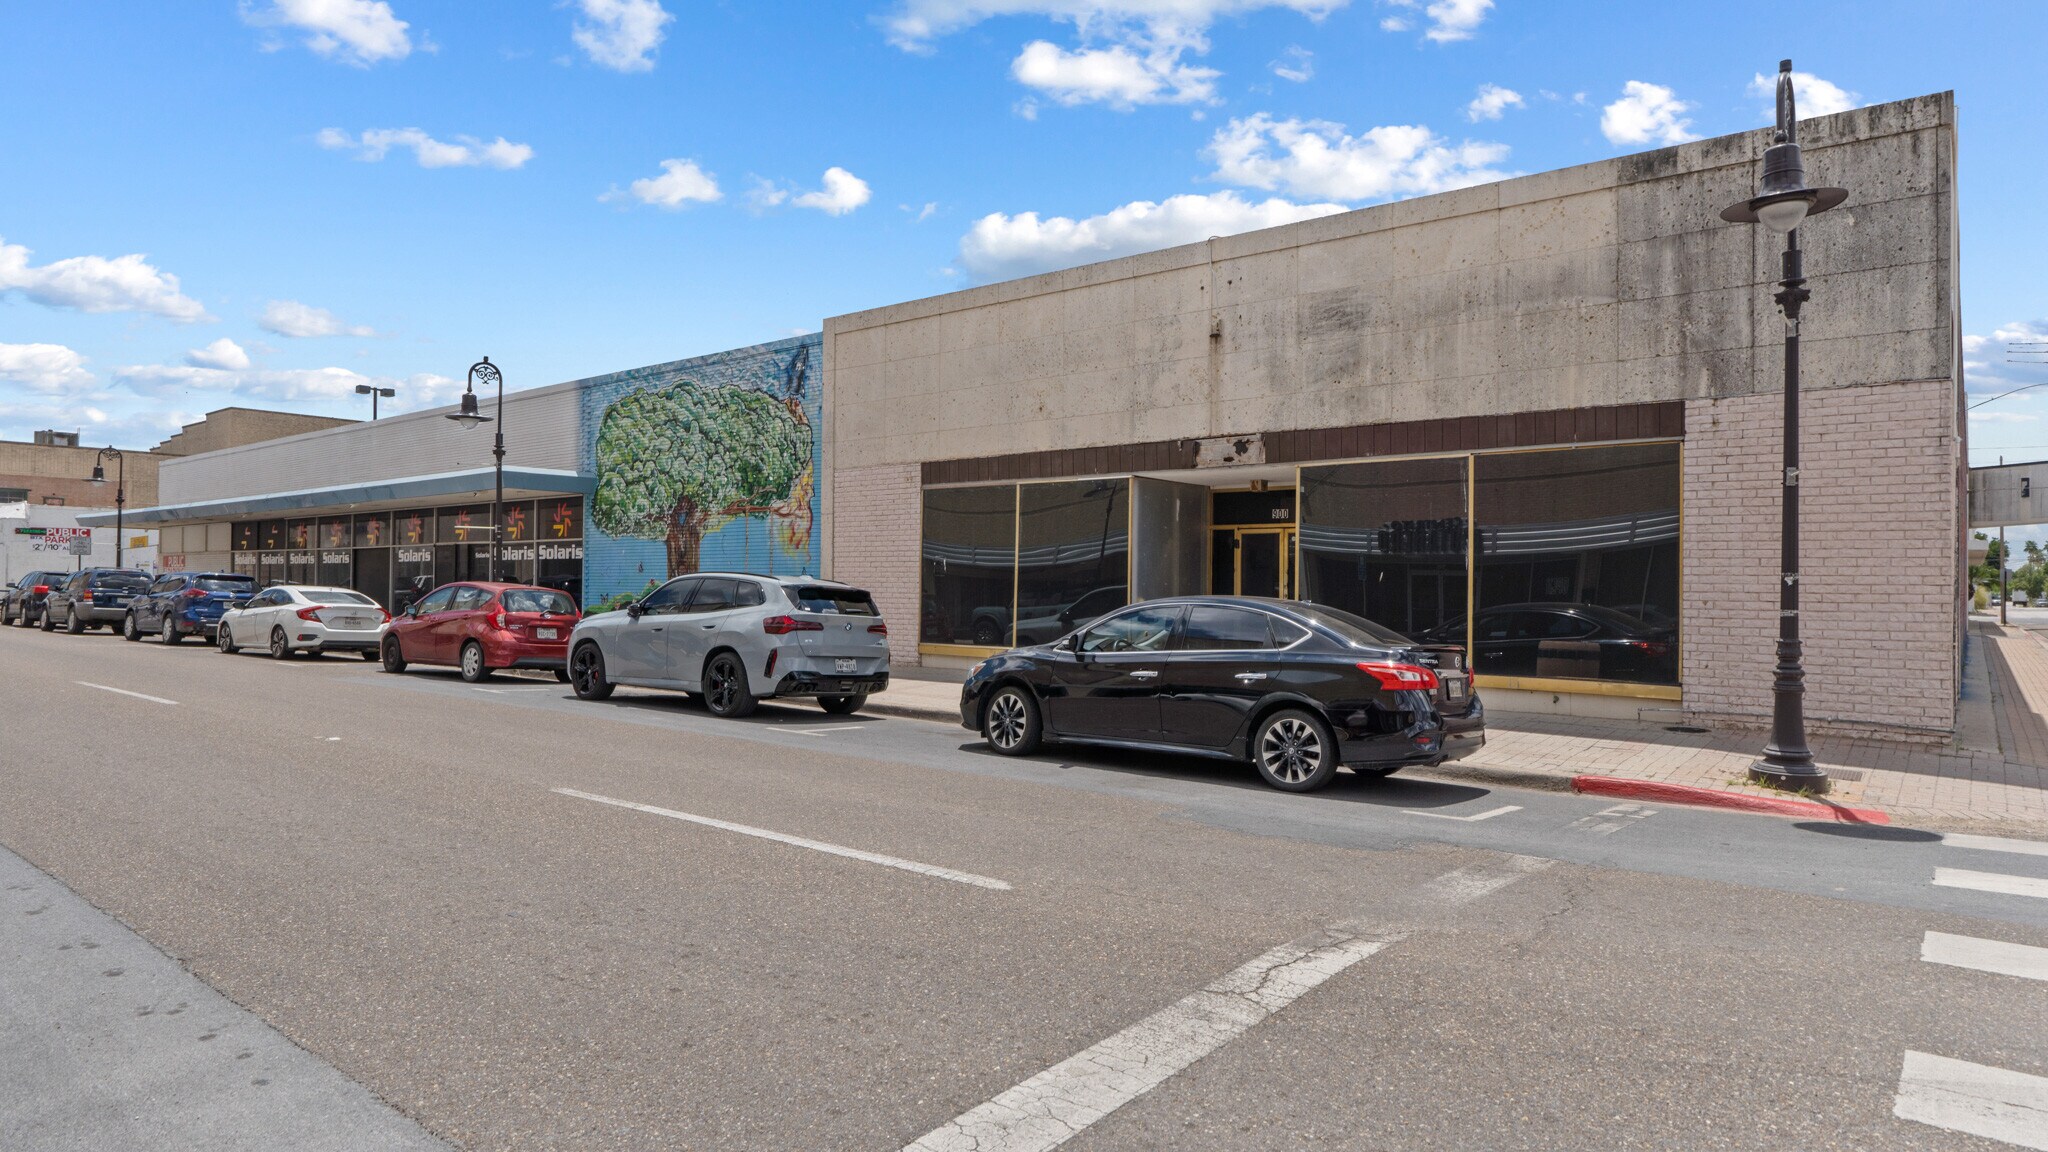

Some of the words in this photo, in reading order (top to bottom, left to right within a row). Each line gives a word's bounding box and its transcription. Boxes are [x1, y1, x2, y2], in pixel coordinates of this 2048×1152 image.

[1272, 508, 1289, 519] 900
[46, 528, 87, 537] PUBLIC
[45, 536, 71, 544] PARK
[398, 549, 431, 562] Solaris
[538, 543, 583, 560] Solaris
[234, 553, 256, 565] Solaris
[261, 553, 284, 565] Solaris
[290, 553, 315, 564] Solaris
[322, 552, 350, 564] Solaris
